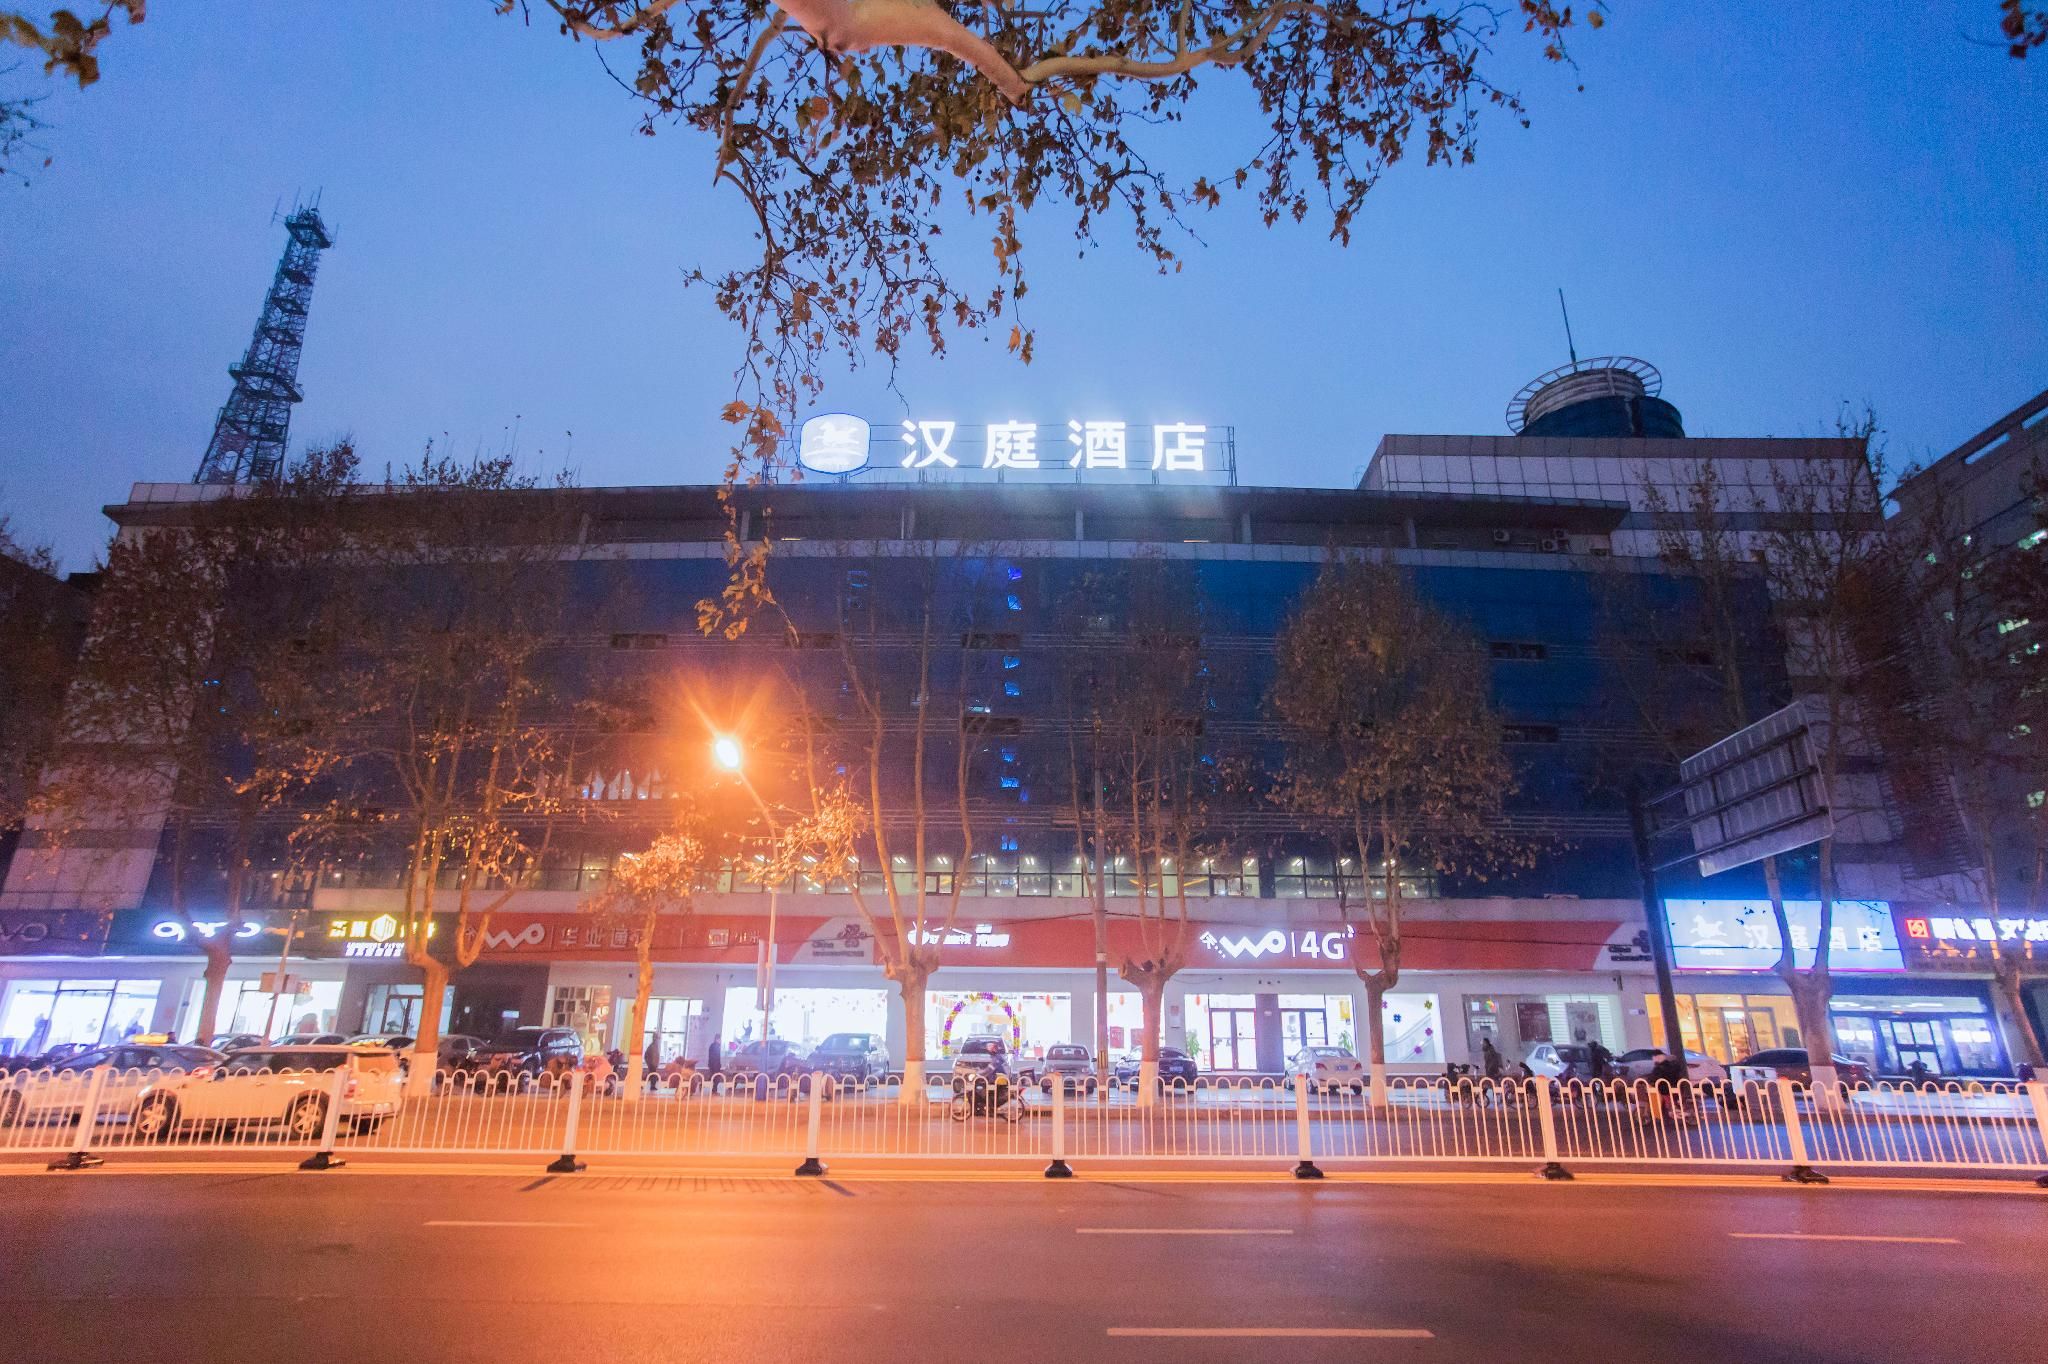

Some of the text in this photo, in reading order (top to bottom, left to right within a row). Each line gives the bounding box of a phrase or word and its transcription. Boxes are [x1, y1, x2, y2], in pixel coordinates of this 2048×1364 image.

[901, 419, 1207, 471] 汉庭酒店
[1301, 931, 1345, 960] 4G
